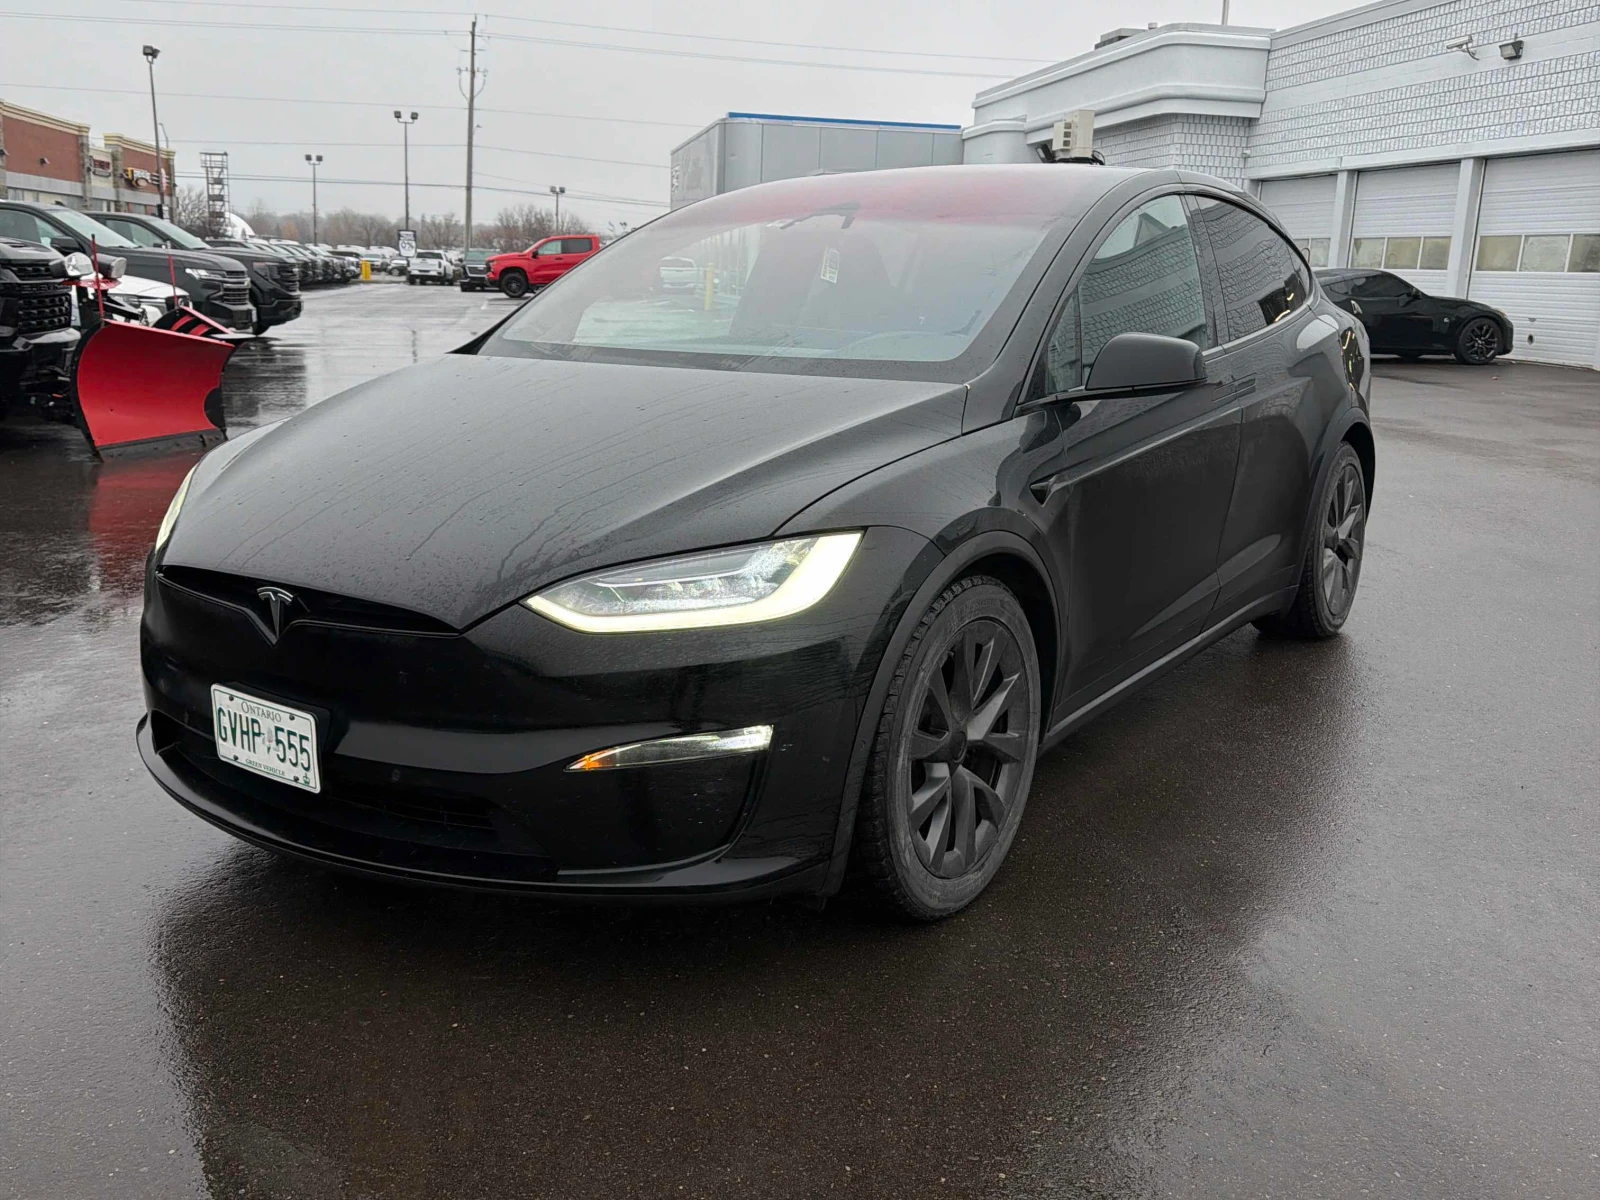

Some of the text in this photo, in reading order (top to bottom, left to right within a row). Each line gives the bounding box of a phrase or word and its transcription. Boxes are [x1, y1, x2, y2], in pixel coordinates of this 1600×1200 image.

[241, 701, 281, 722] ONTARIO
[217, 707, 310, 772] GVHP 555
[245, 758, 285, 776] GREEN VEHICLE
